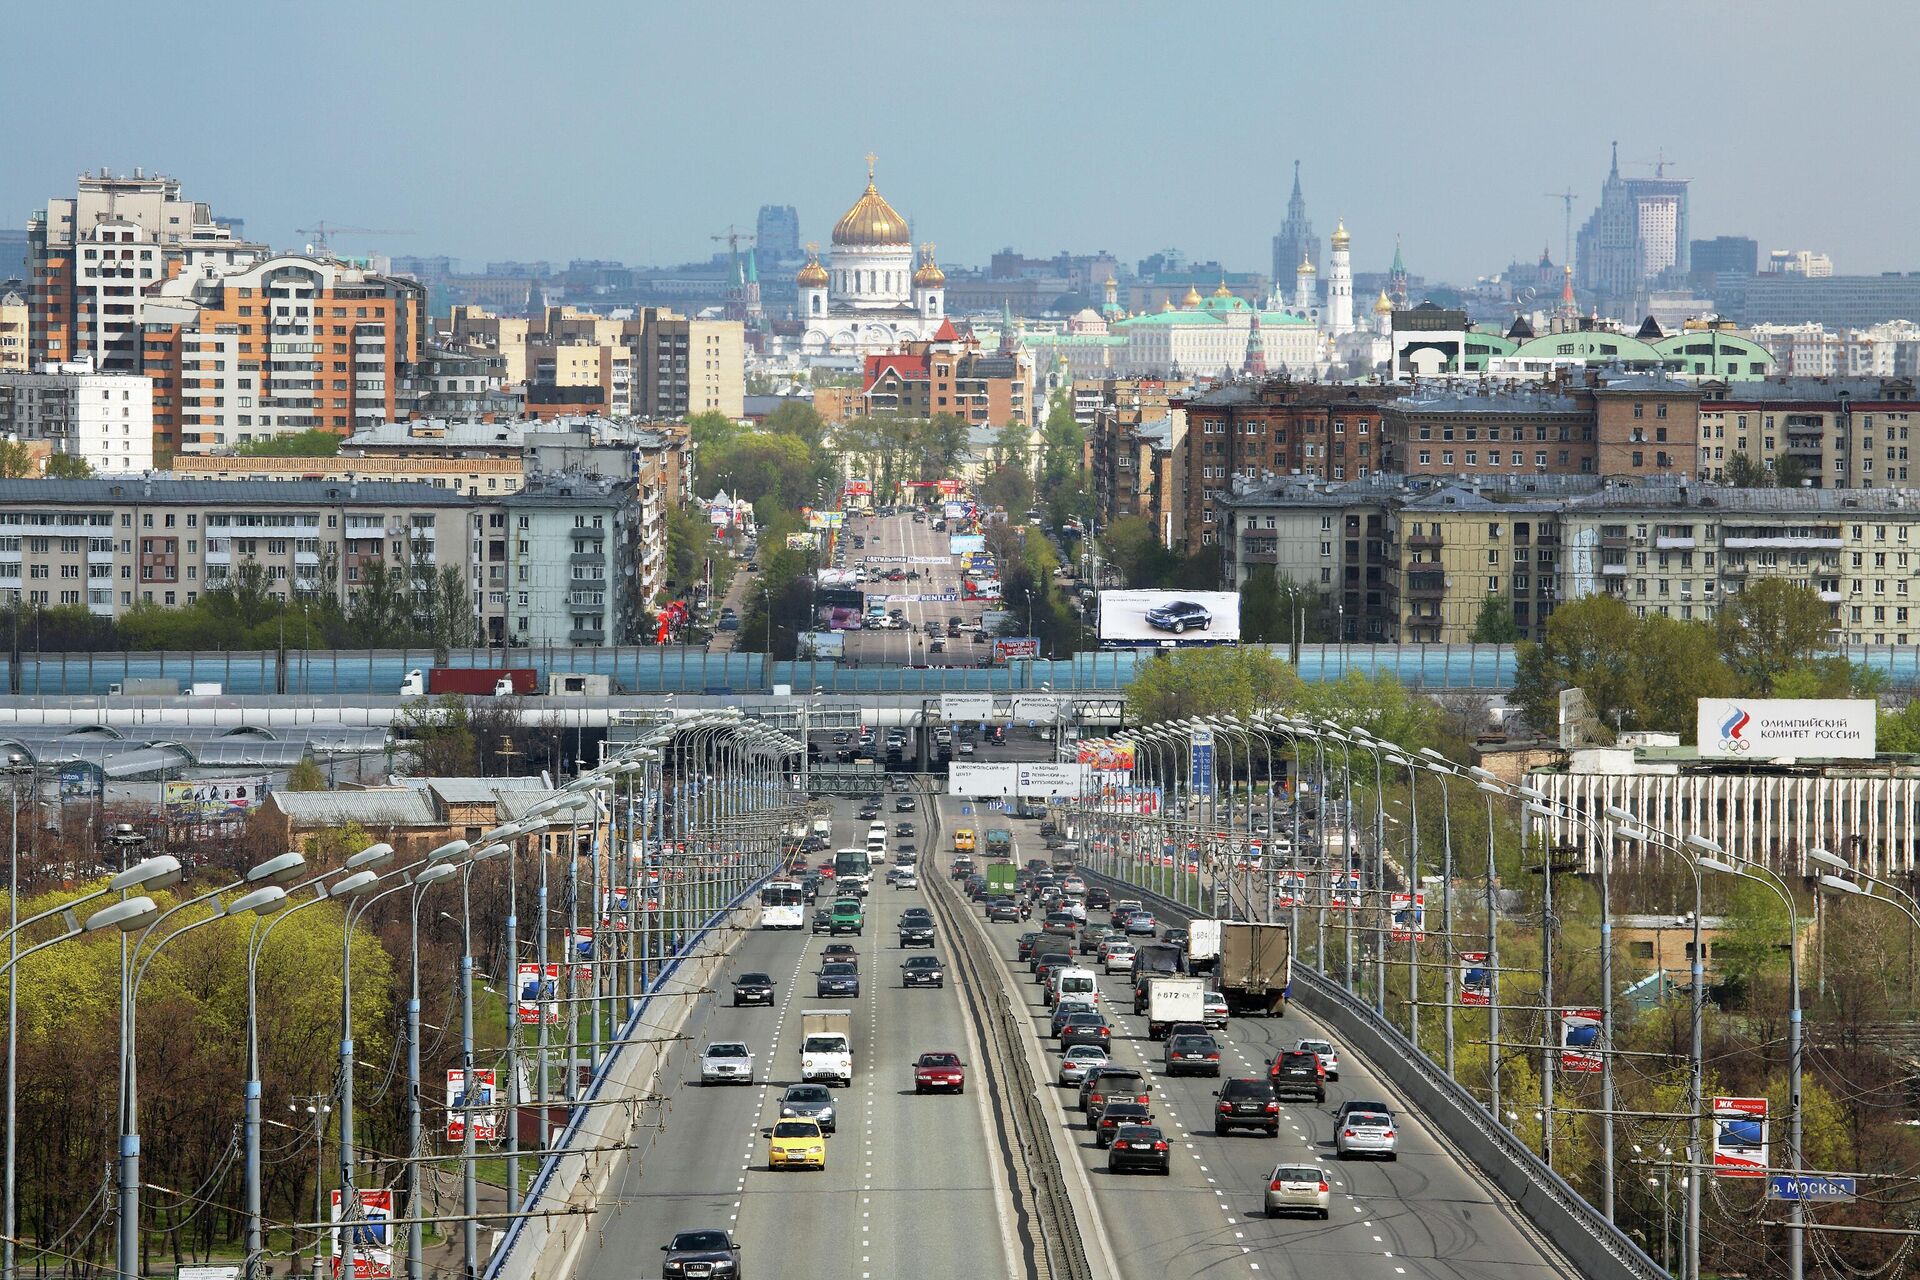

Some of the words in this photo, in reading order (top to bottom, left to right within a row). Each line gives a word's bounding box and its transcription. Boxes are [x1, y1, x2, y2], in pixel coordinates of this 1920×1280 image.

[1761, 717, 1847, 728] ОЛИМПИЙСКИЙ
[1761, 730, 1809, 739] КОМИТЕТ
[1815, 730, 1860, 740] РОССИИ
[1718, 1100, 1733, 1108] ЖК
[1772, 1183, 1783, 1195] р.
[1787, 1182, 1847, 1195] МОСКВА
